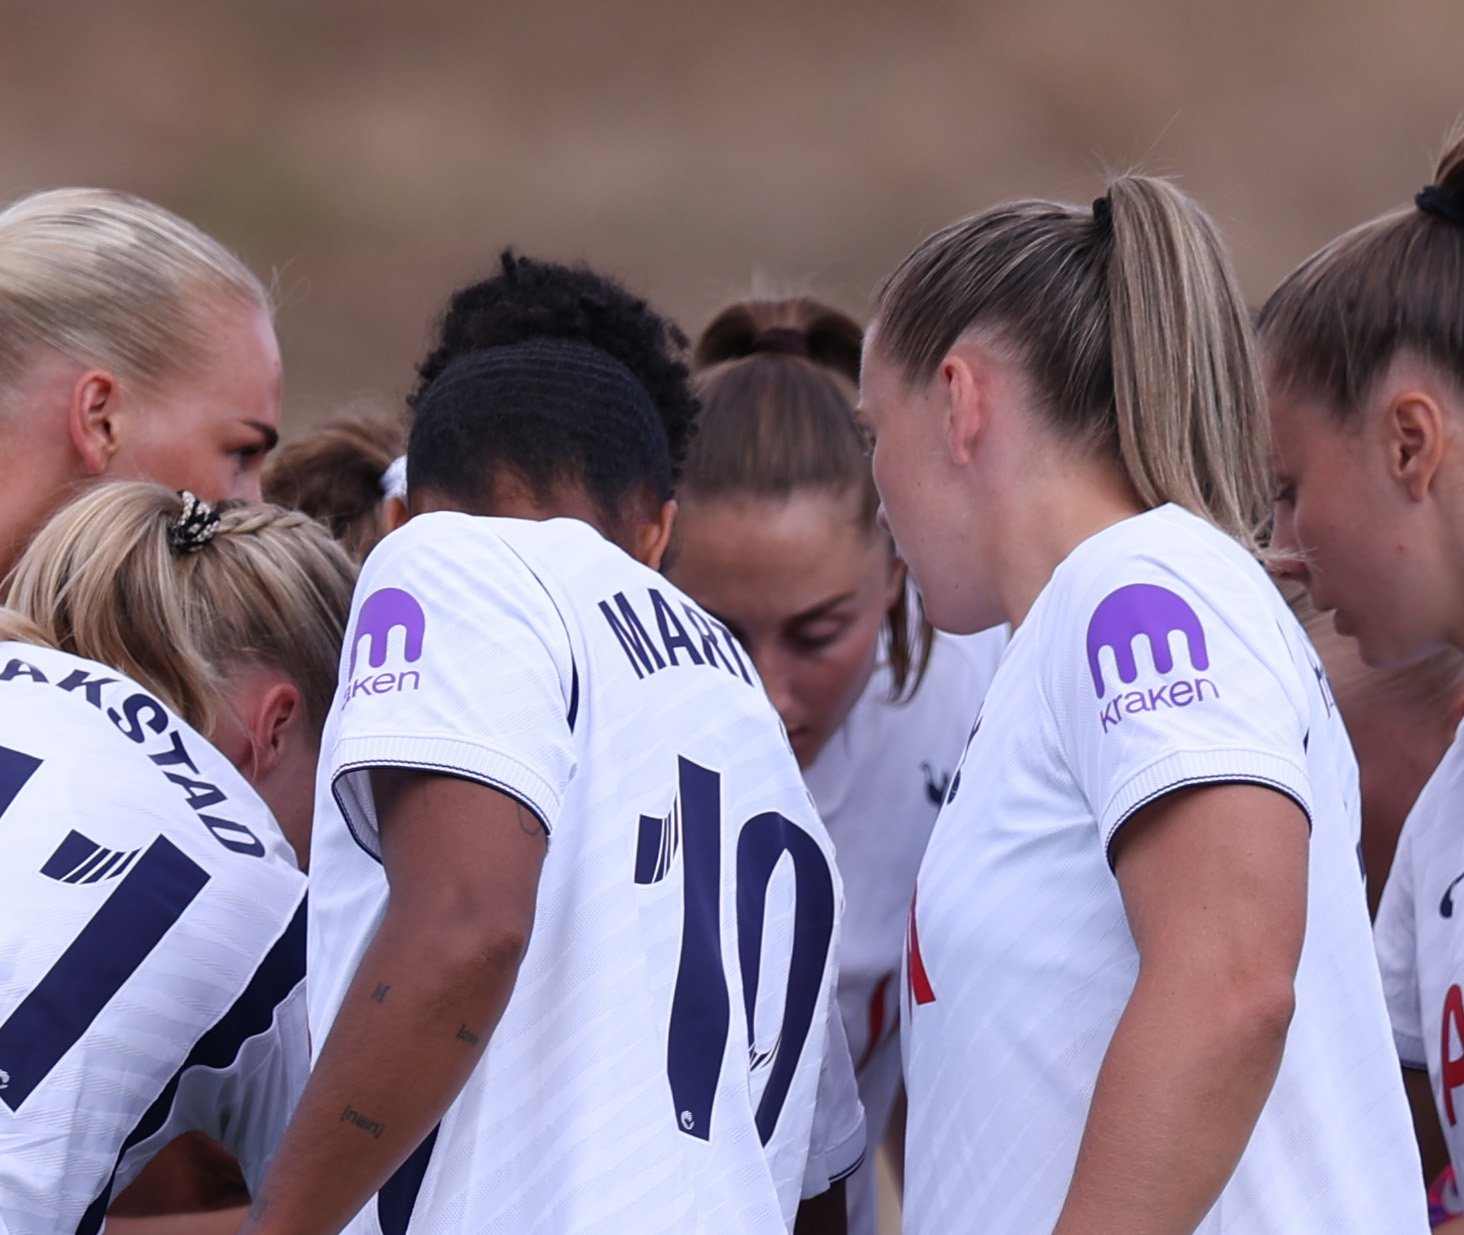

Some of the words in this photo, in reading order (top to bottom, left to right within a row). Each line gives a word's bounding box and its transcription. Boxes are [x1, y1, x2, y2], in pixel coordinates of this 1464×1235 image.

[598, 587, 755, 688] MART
[1100, 678, 1220, 734] kraken
[634, 754, 835, 1148] 10
